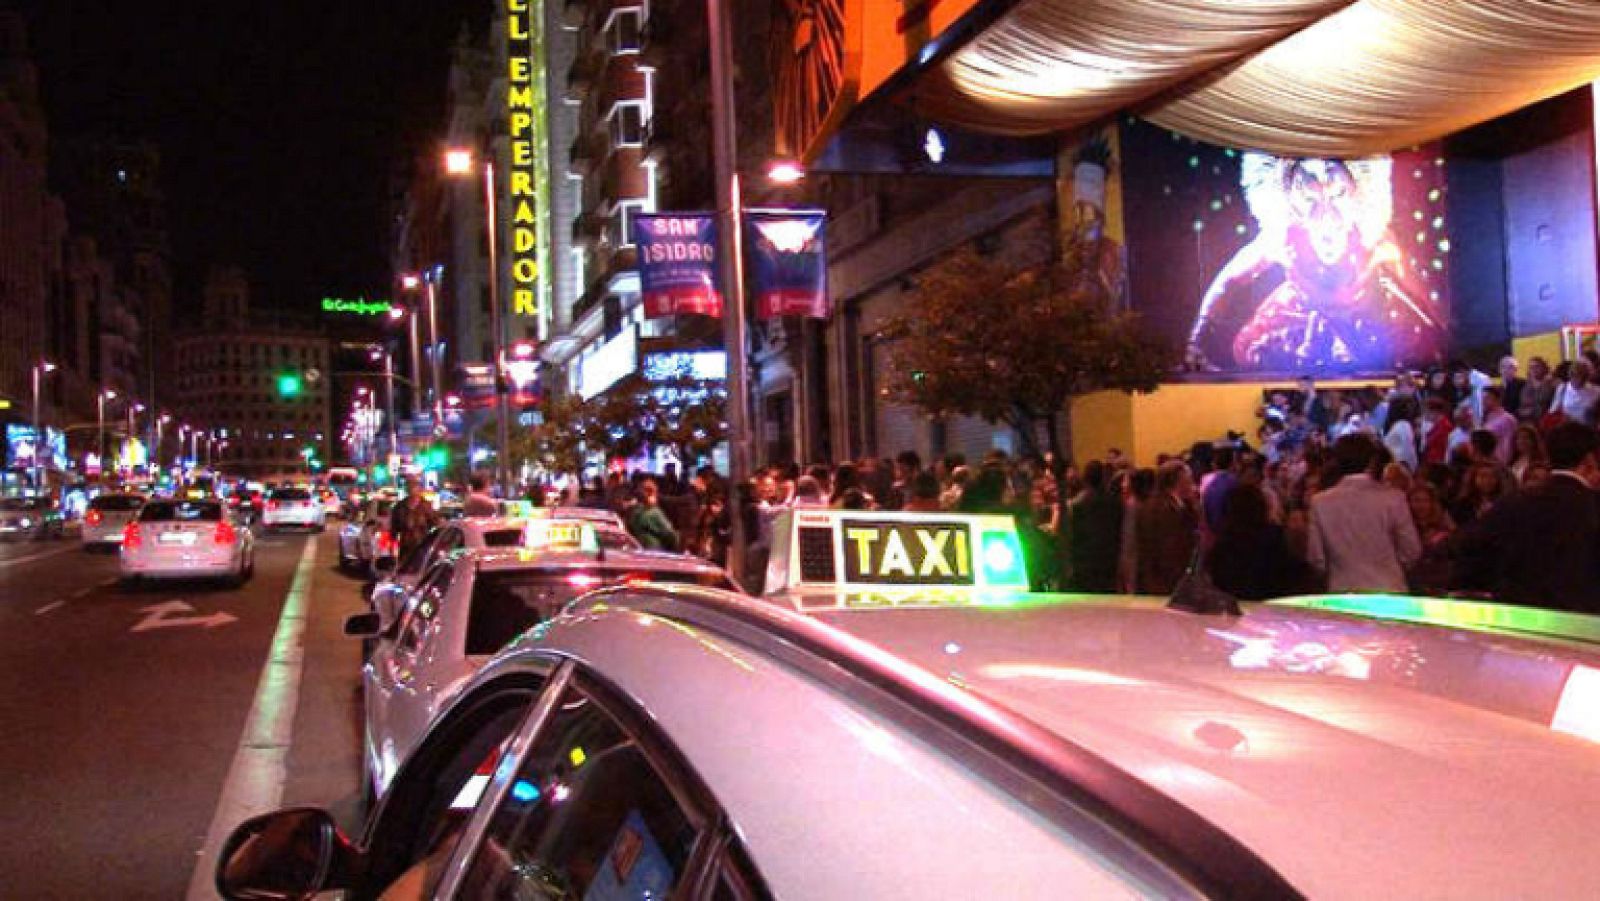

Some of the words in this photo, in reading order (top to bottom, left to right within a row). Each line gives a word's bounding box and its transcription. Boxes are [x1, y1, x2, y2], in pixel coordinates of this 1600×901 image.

[508, 57, 538, 316] EMPERADOR
[653, 218, 698, 236] SAN
[643, 242, 714, 264] ISIDRO
[847, 528, 969, 577] TAXI
